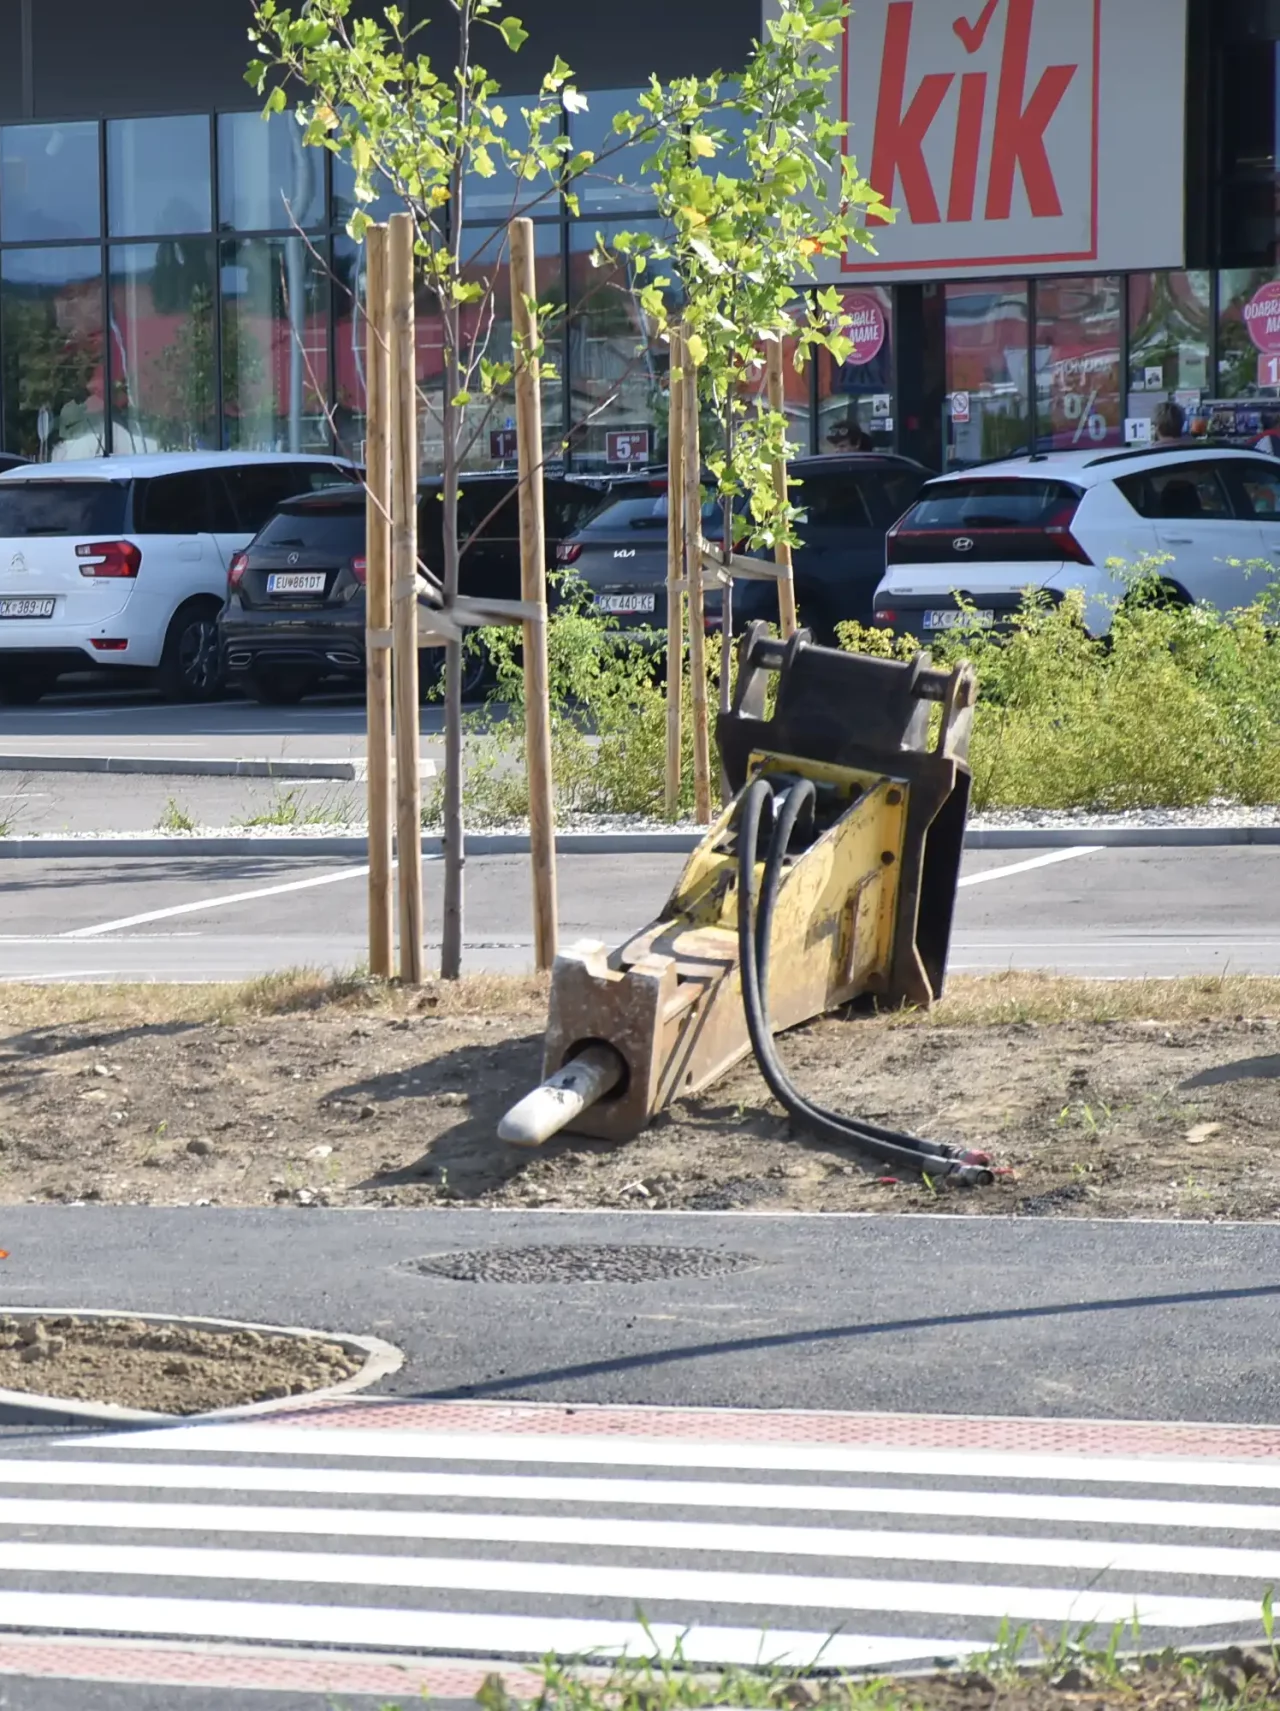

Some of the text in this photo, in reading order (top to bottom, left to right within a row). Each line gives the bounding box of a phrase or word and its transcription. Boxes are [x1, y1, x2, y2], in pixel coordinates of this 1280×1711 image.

[865, 0, 1078, 227] kik
[1244, 299, 1280, 320] ODABR
[849, 325, 879, 342] MAME
[616, 436, 631, 459] 5
[17, 601, 52, 613] 389-IC
[618, 596, 654, 609] 440-KE
